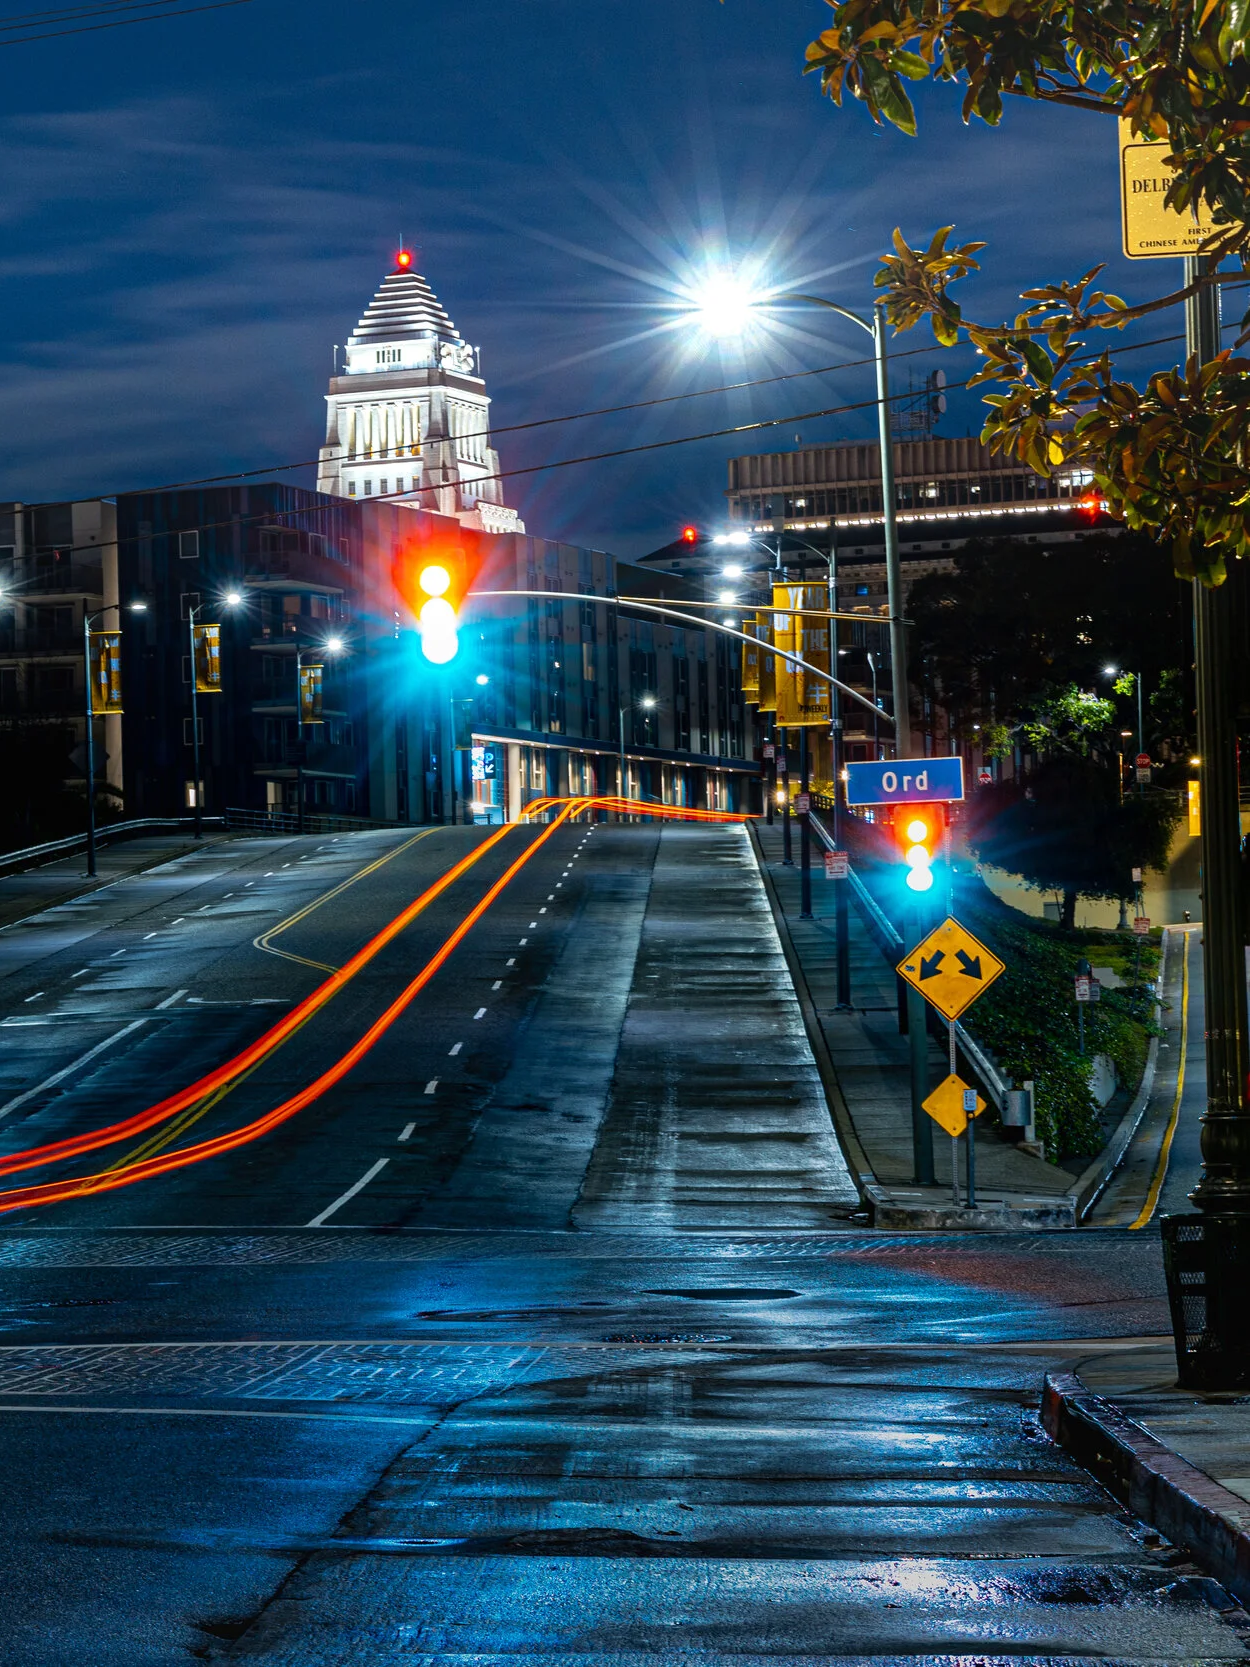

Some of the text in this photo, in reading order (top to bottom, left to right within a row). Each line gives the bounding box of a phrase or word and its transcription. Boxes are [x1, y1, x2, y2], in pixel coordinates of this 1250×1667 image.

[1132, 178, 1173, 194] DELB
[1188, 227, 1212, 235] FIRST
[1139, 239, 1178, 248] CHINESE
[787, 586, 825, 609] YEAR
[774, 612, 791, 631] OF
[801, 629, 828, 651] THE
[785, 650, 805, 674] OX
[806, 682, 829, 704] 牛
[882, 770, 928, 793] Ord
